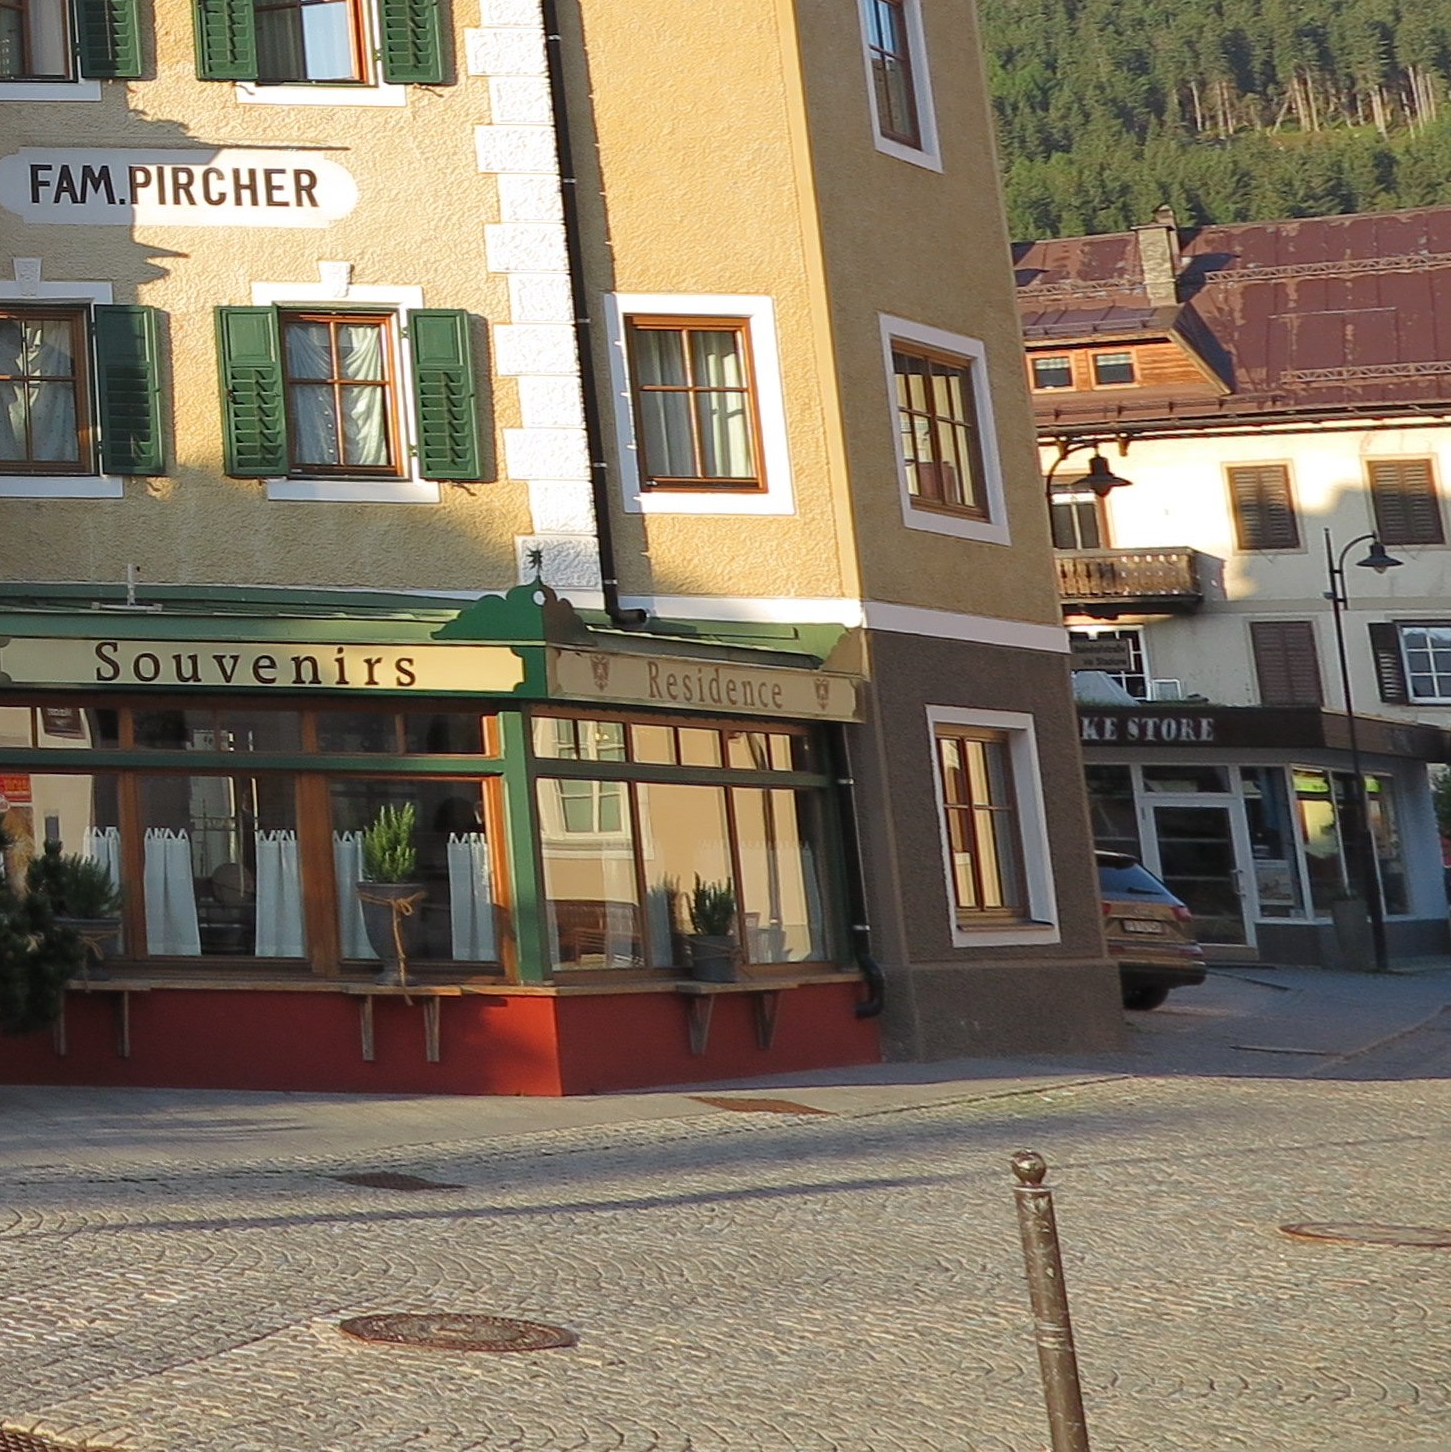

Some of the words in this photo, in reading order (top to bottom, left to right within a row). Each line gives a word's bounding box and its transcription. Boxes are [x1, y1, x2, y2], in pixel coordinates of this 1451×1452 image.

[94, 641, 416, 687] Souvenirs
[646, 660, 783, 709] Residence
[1126, 717, 1214, 741] STORE
